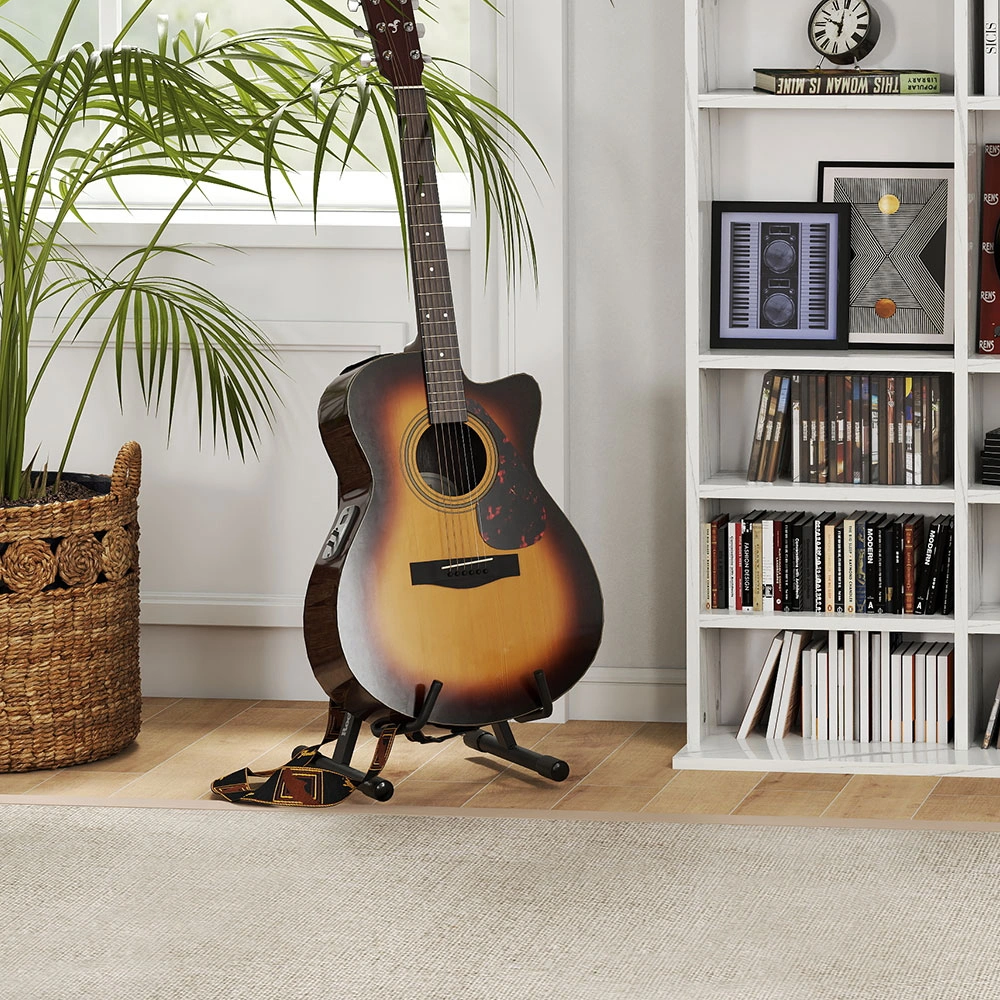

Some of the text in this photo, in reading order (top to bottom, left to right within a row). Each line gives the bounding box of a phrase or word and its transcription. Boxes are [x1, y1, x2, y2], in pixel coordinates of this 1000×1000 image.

[986, 22, 997, 55] SICIS
[777, 77, 900, 94] THIS WOMAN IS MINE
[924, 530, 935, 566] MODERN
